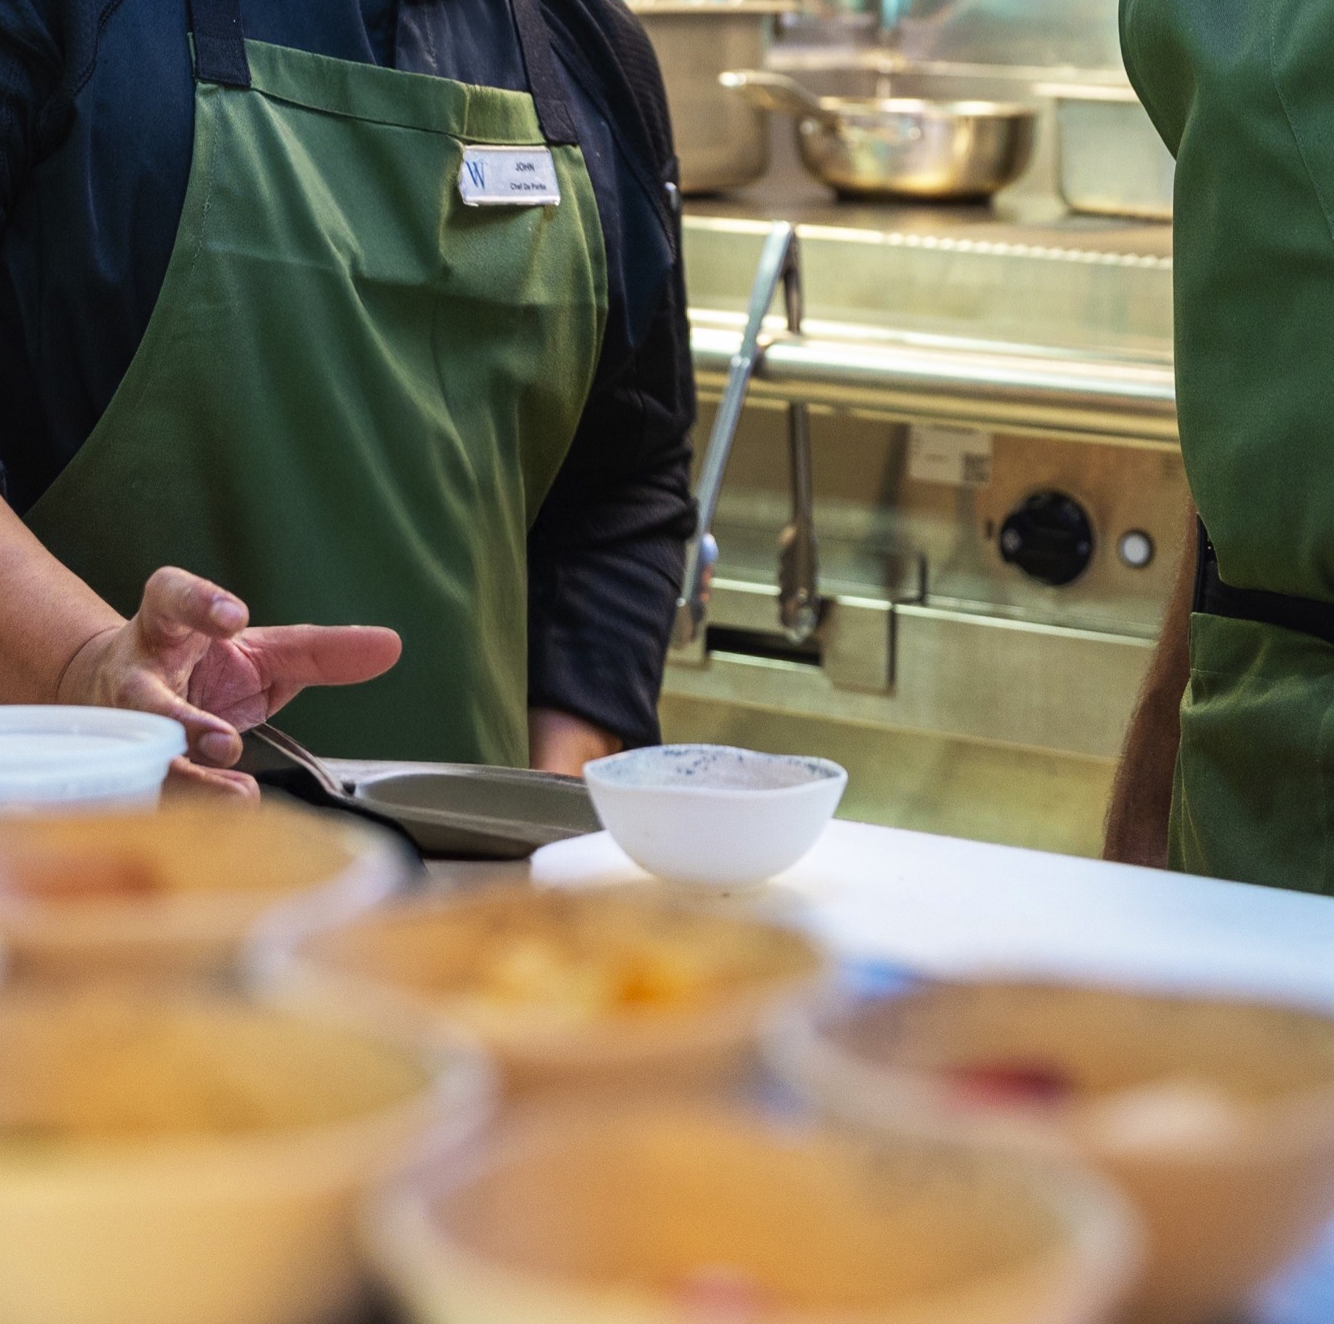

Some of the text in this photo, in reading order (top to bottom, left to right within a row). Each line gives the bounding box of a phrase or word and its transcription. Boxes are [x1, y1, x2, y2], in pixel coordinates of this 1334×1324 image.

[515, 162, 535, 172] JOHN
[465, 160, 486, 190] W
[510, 182, 522, 190] Chef
